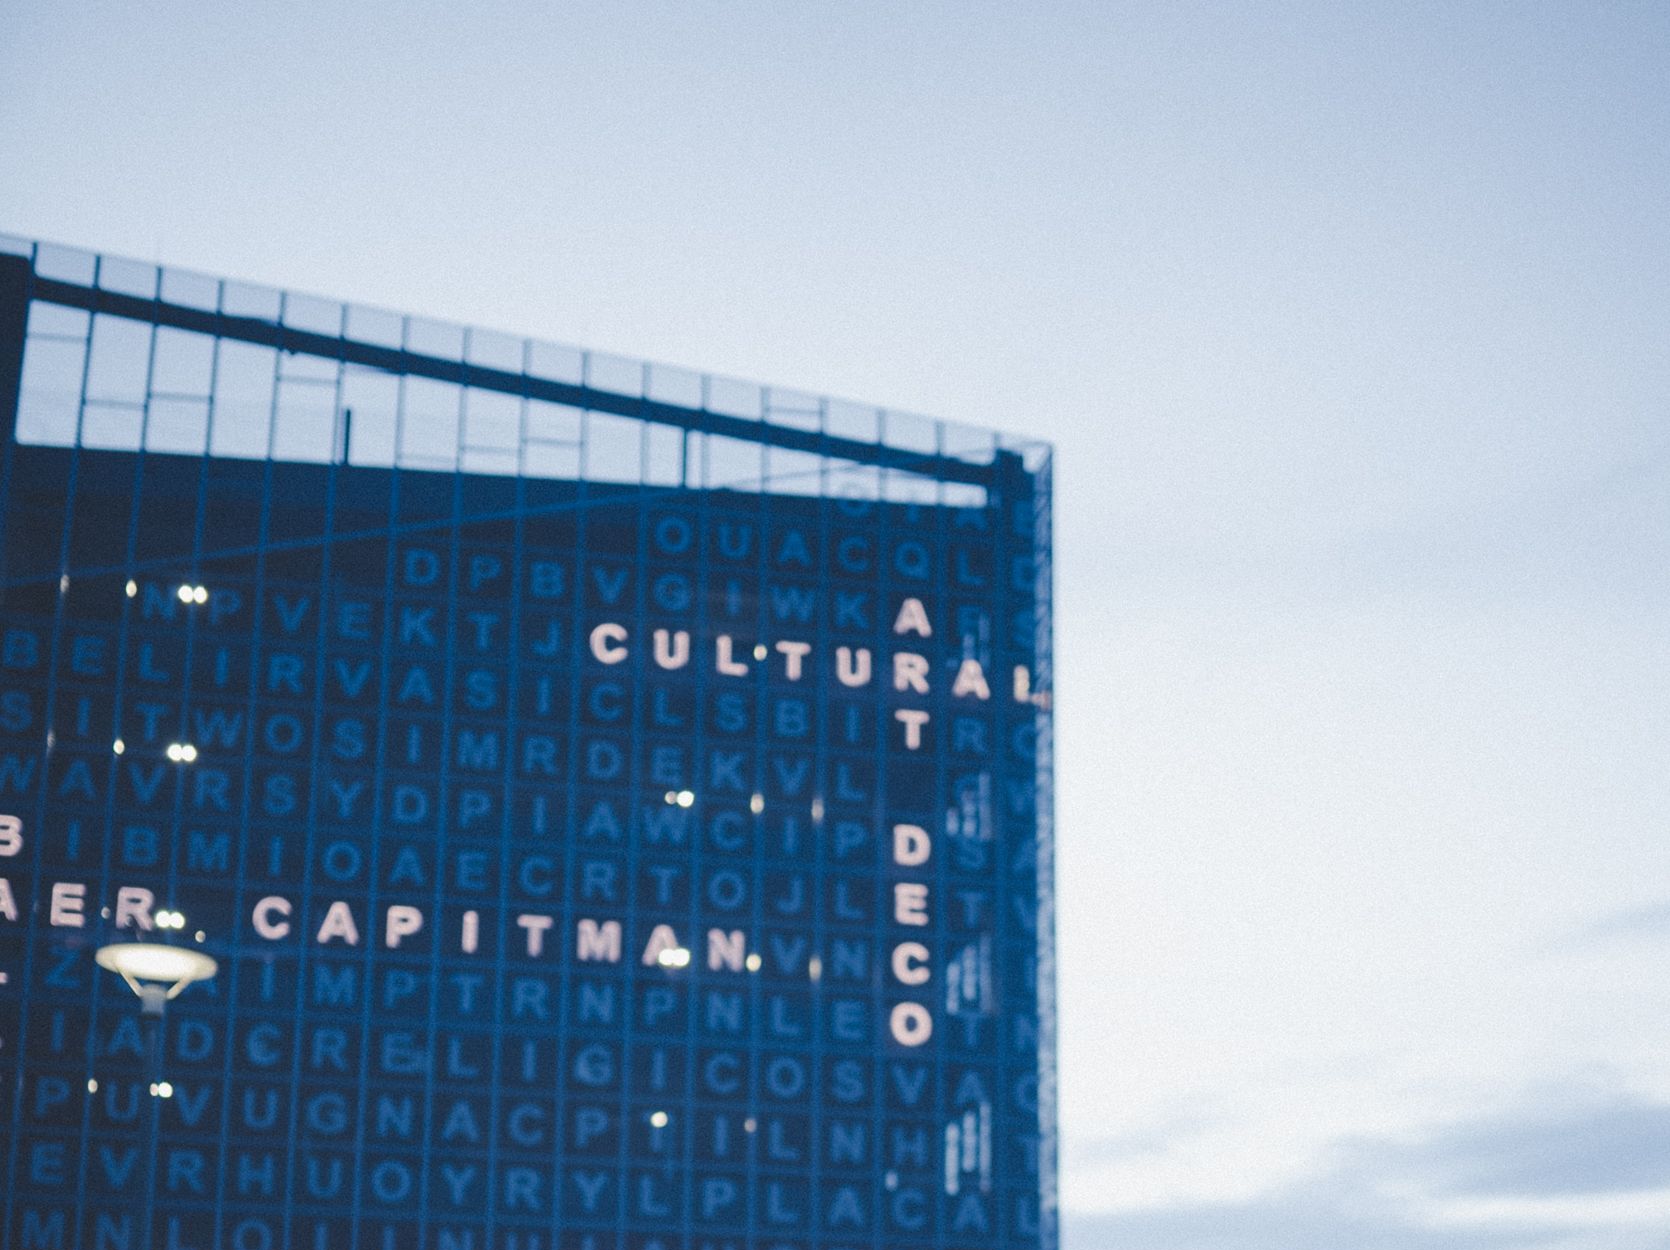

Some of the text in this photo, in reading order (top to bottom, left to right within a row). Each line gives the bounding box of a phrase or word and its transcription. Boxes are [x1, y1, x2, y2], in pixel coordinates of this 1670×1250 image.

[589, 622, 1052, 708] CULTURAL
[891, 597, 932, 750] ART
[252, 895, 746, 973] CAPITMAN
[889, 823, 933, 1047] DECO
